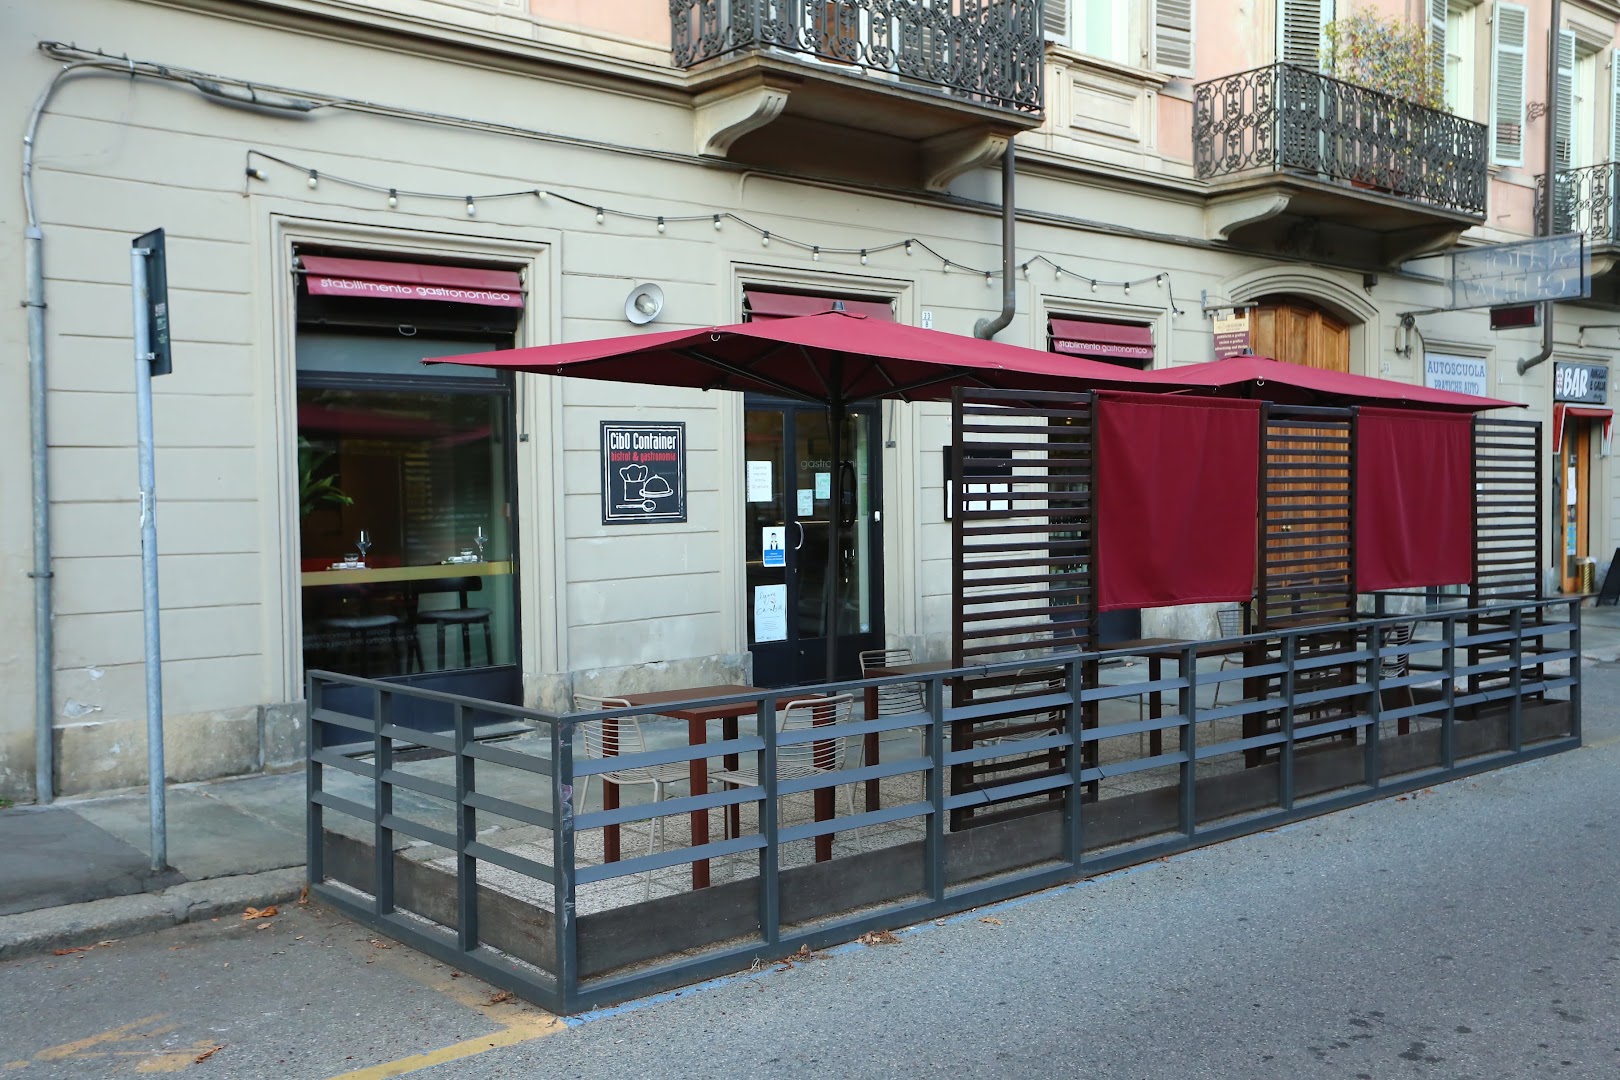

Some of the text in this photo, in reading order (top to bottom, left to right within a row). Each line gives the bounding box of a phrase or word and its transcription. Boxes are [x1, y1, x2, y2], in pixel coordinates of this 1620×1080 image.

[320, 278, 511, 302] stabilimento gastronomico
[1059, 340, 1148, 355] stabilimento gastronomico
[1427, 361, 1486, 377] AUTOSCUOLA
[1434, 379, 1480, 395] PRATICHE AUTO
[1562, 367, 1589, 399] BAR
[633, 432, 677, 450] Container
[611, 451, 677, 463] bistrot & gastronomia
